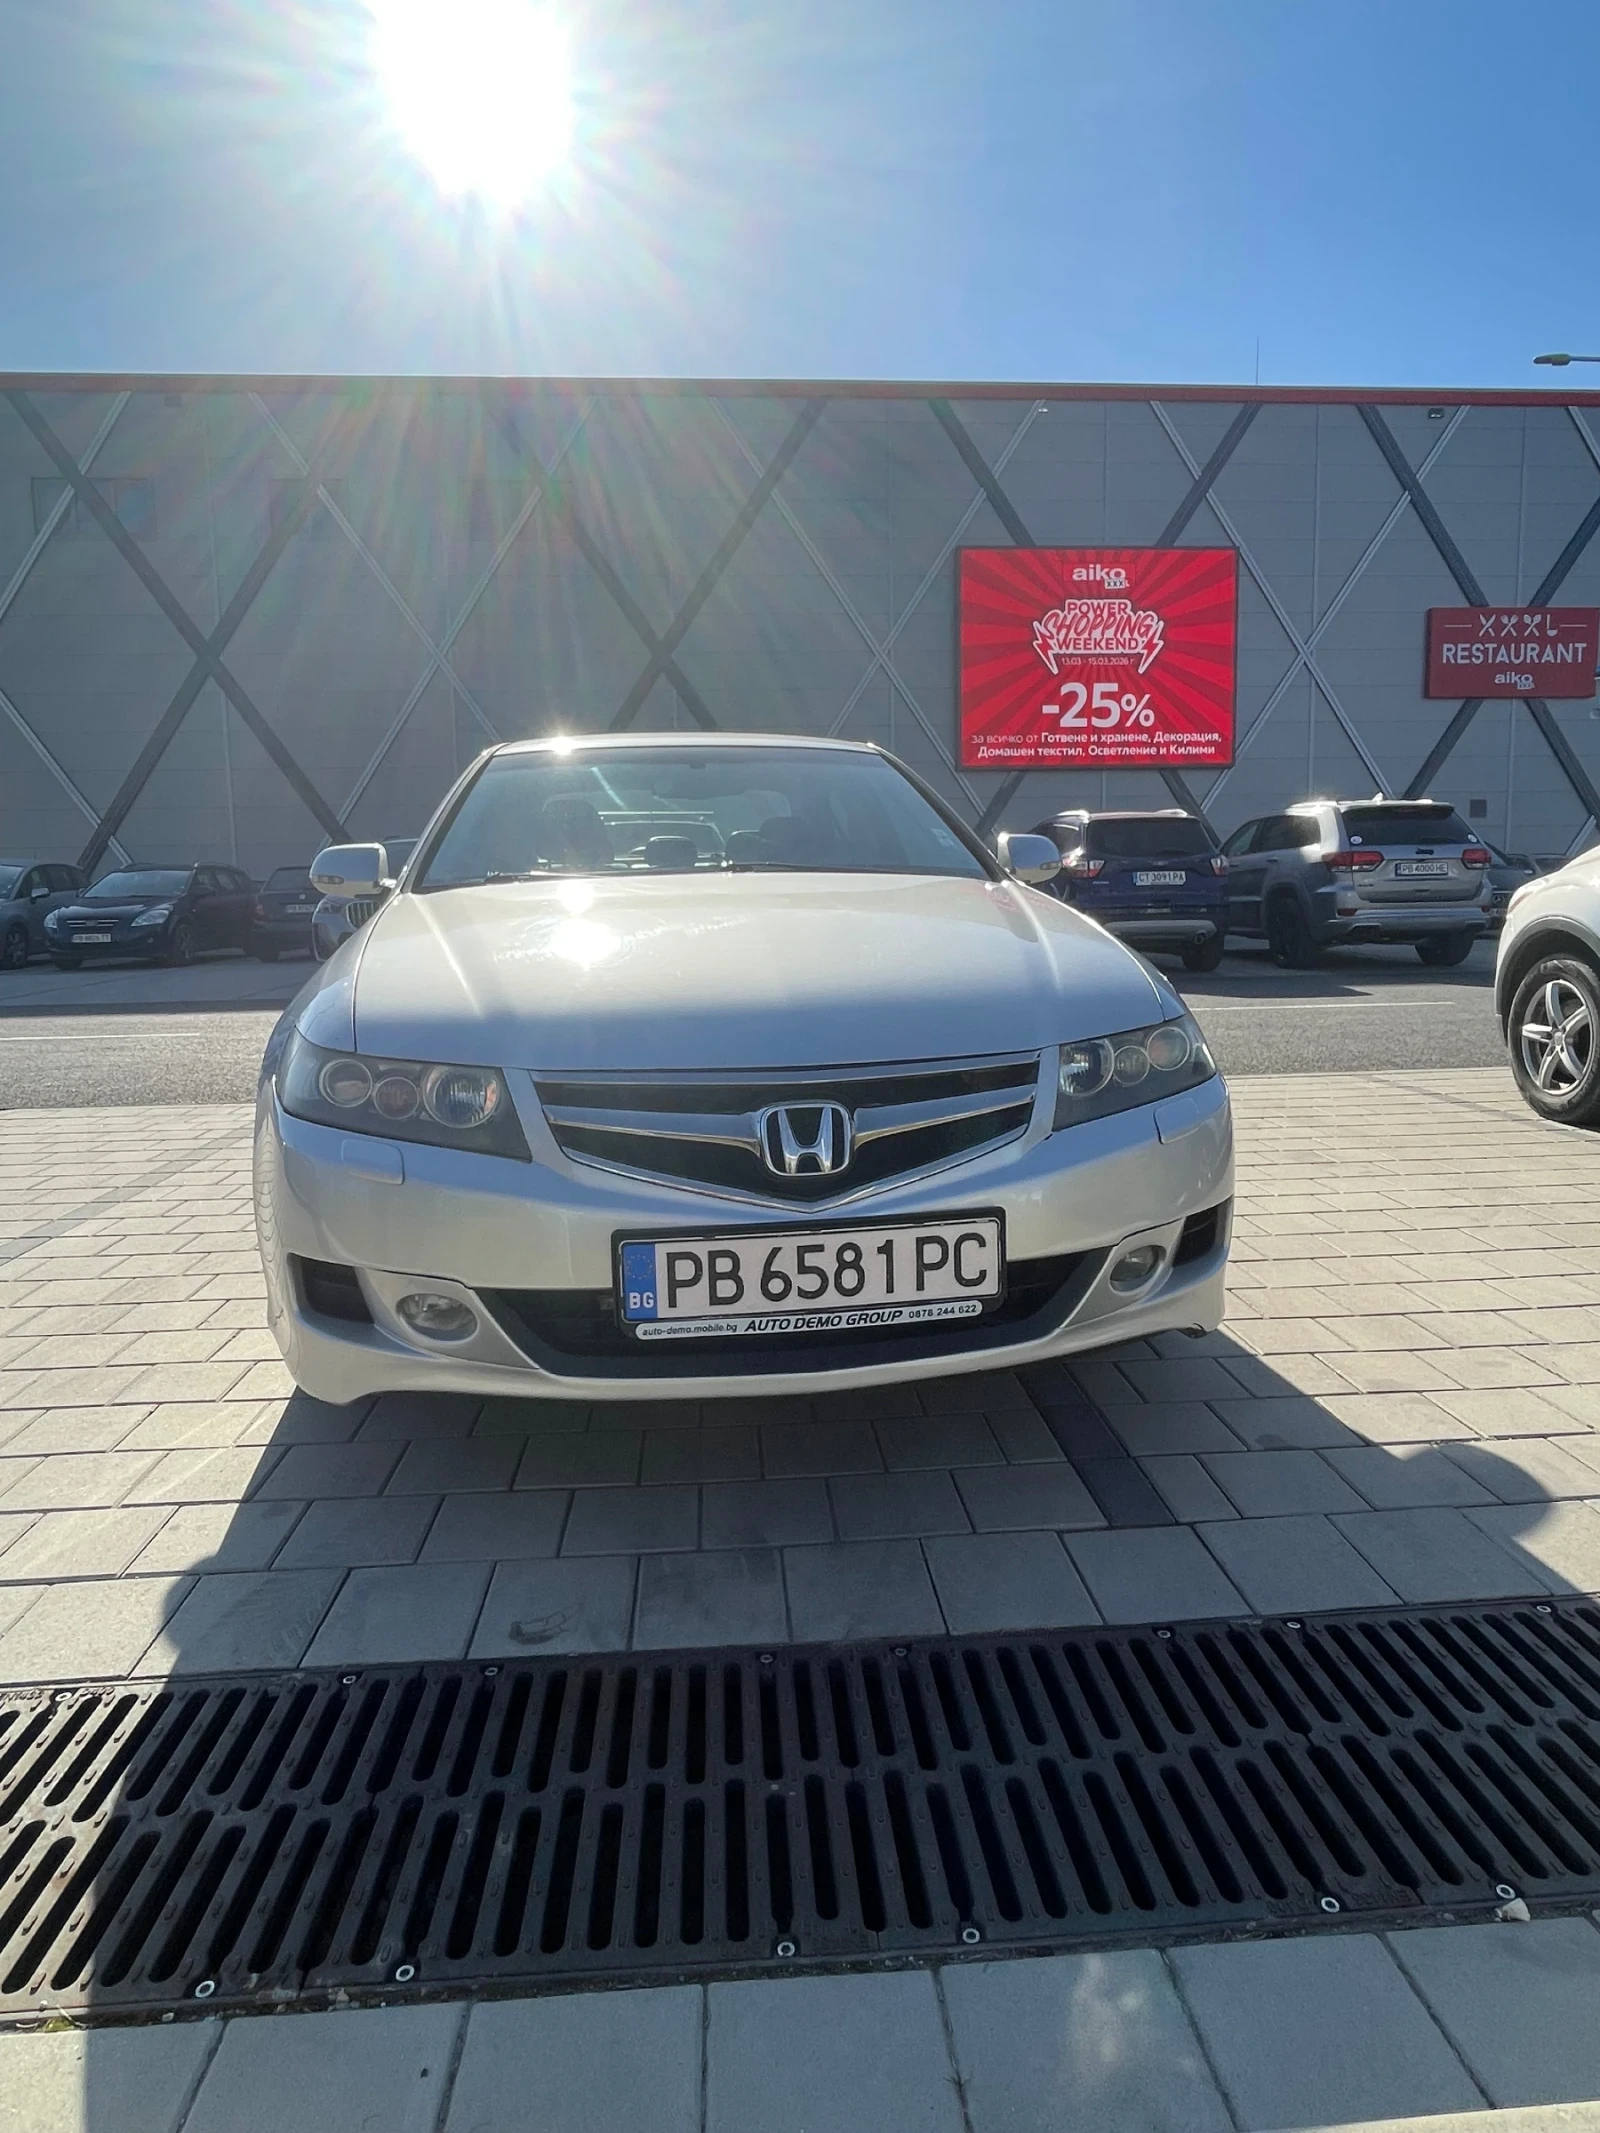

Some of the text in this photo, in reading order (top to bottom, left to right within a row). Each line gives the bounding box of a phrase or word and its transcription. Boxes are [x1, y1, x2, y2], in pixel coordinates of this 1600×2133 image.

[1072, 564, 1126, 580] aiko
[1067, 602, 1128, 615] POWER
[1043, 611, 1155, 640] SHOPPING
[1057, 638, 1138, 650] WEEKEND
[1442, 643, 1587, 664] RESTAURANT
[1062, 657, 1081, 665] 13.03
[1088, 657, 1128, 665] 15.03.2026
[1494, 671, 1533, 684] aiko
[1042, 682, 1155, 728] -25%
[971, 731, 1222, 744] за всичко от Готвене и хранене, Декорация,
[978, 744, 1215, 758] Домашен текстил, Осветление и Килими
[1402, 864, 1413, 872] PB
[1415, 864, 1435, 872] 4000
[1139, 873, 1149, 882] CT
[666, 1232, 987, 1308] PB 6581 PC
[629, 1292, 654, 1309] BG
[642, 1304, 977, 1337] auto-demo.mobile.bg AUTO DEMO GROUP 0878 244 622
